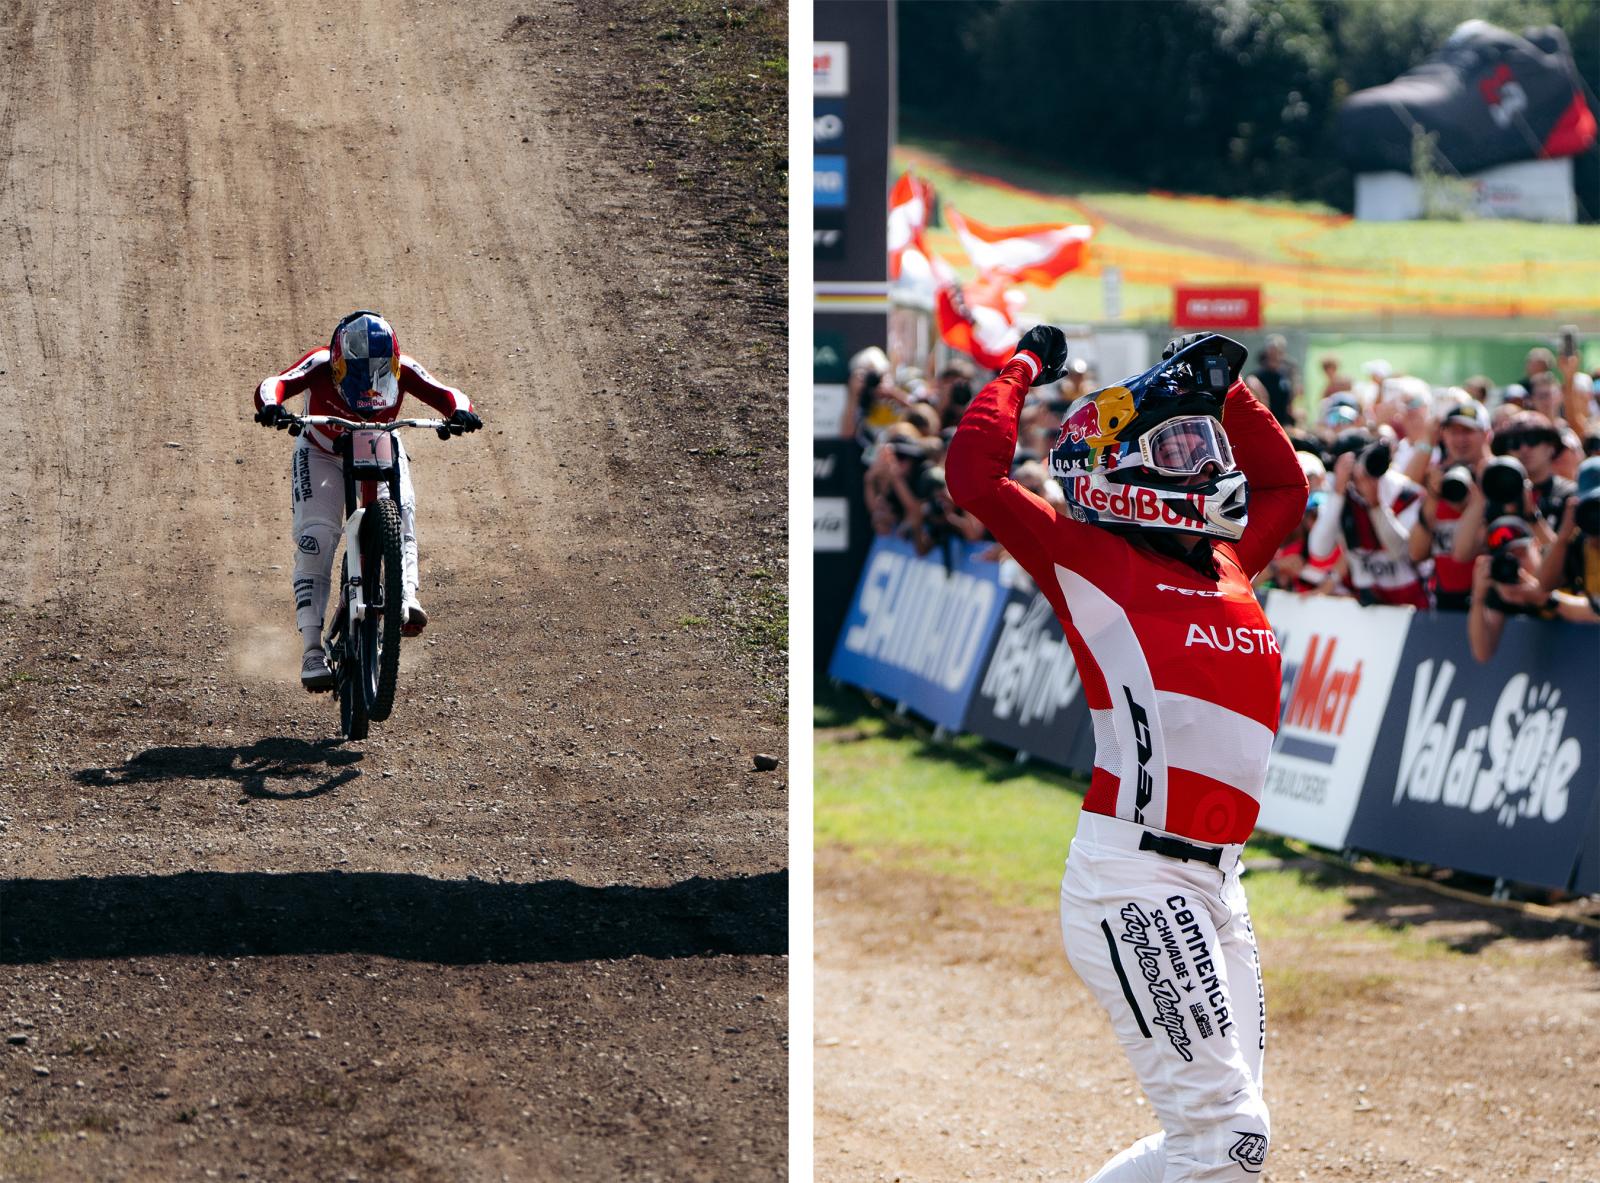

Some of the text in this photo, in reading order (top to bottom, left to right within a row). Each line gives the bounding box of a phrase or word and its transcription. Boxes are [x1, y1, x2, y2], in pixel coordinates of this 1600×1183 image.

[357, 400, 372, 408] Red
[373, 399, 387, 407] Bull
[1055, 450, 1124, 471] OAKLEY
[1074, 476, 1206, 529] Red Bull
[1156, 583, 1228, 597] FELT
[1392, 658, 1467, 807] Val
[1469, 672, 1582, 824] Sole
[1150, 909, 1189, 980] SCHWALBE
[1166, 895, 1234, 1038] COMMENCAL
[1120, 903, 1194, 1062] Troy Lee Designs
[1195, 1001, 1214, 1037] LES ORRES
